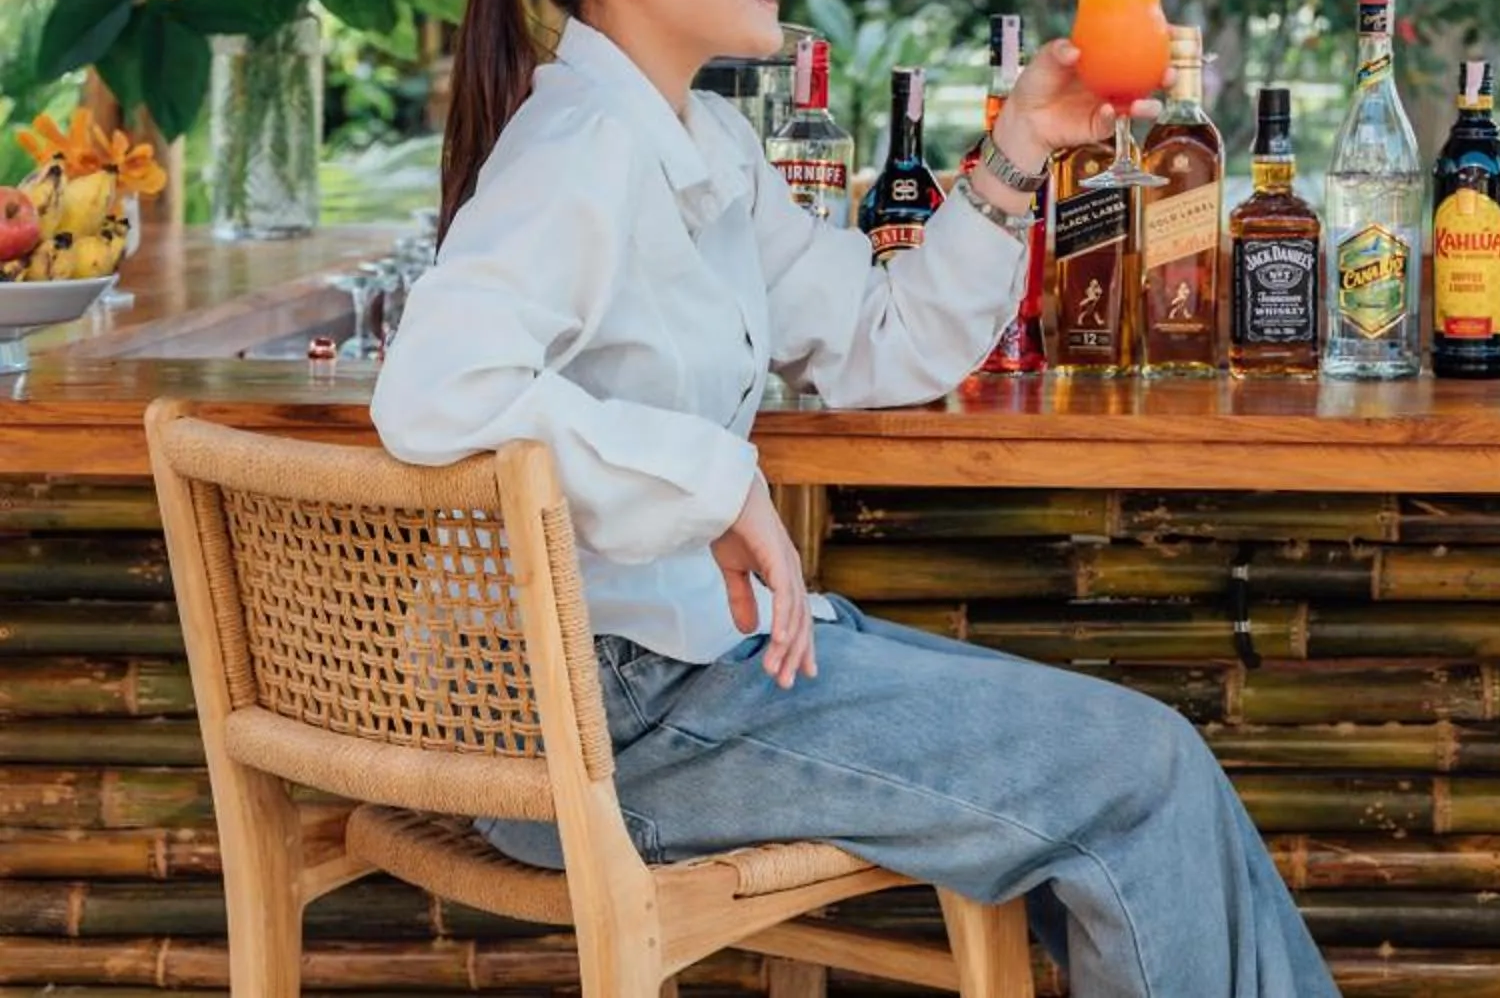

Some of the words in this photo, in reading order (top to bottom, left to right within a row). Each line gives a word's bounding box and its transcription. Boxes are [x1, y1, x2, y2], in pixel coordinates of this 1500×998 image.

[777, 165, 843, 187] IRNOFF
[871, 227, 922, 248] BAILE
[1246, 250, 1272, 271] JACK
[1083, 334, 1098, 346] 12
